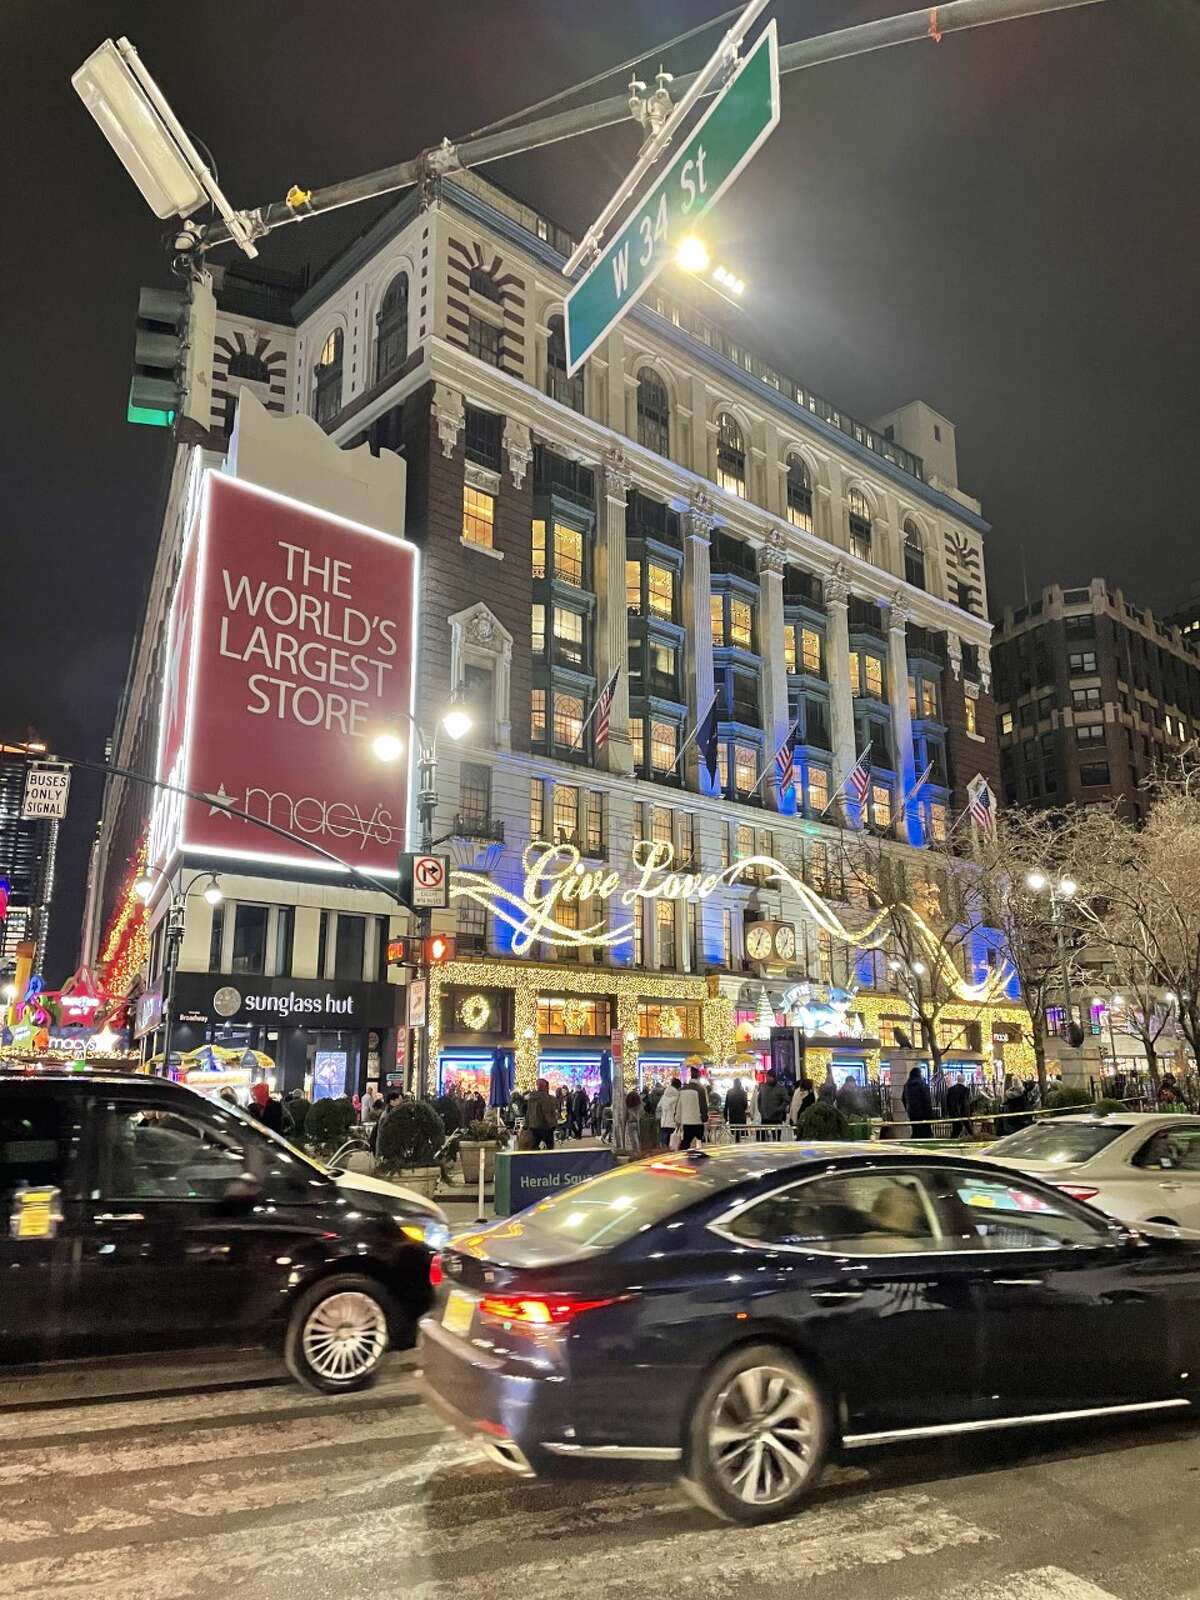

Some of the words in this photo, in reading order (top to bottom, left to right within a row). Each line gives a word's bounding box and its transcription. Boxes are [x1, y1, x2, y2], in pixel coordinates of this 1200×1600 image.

[612, 240, 630, 299] W
[639, 192, 669, 267] 34
[680, 143, 708, 214] St
[278, 540, 353, 600] THE
[221, 568, 398, 656] WORLD'S
[219, 616, 393, 698] LARGEST
[246, 673, 369, 738] STORE
[30, 774, 67, 787] BUSES
[30, 788, 62, 800] ONLY
[26, 801, 62, 815] SIGNAL
[511, 840, 620, 950] Give
[621, 840, 718, 906] Love
[179, 1013, 209, 1023] Broadway
[244, 991, 322, 1017] sunglass
[325, 993, 354, 1014] hut
[520, 1173, 560, 1188] Herald
